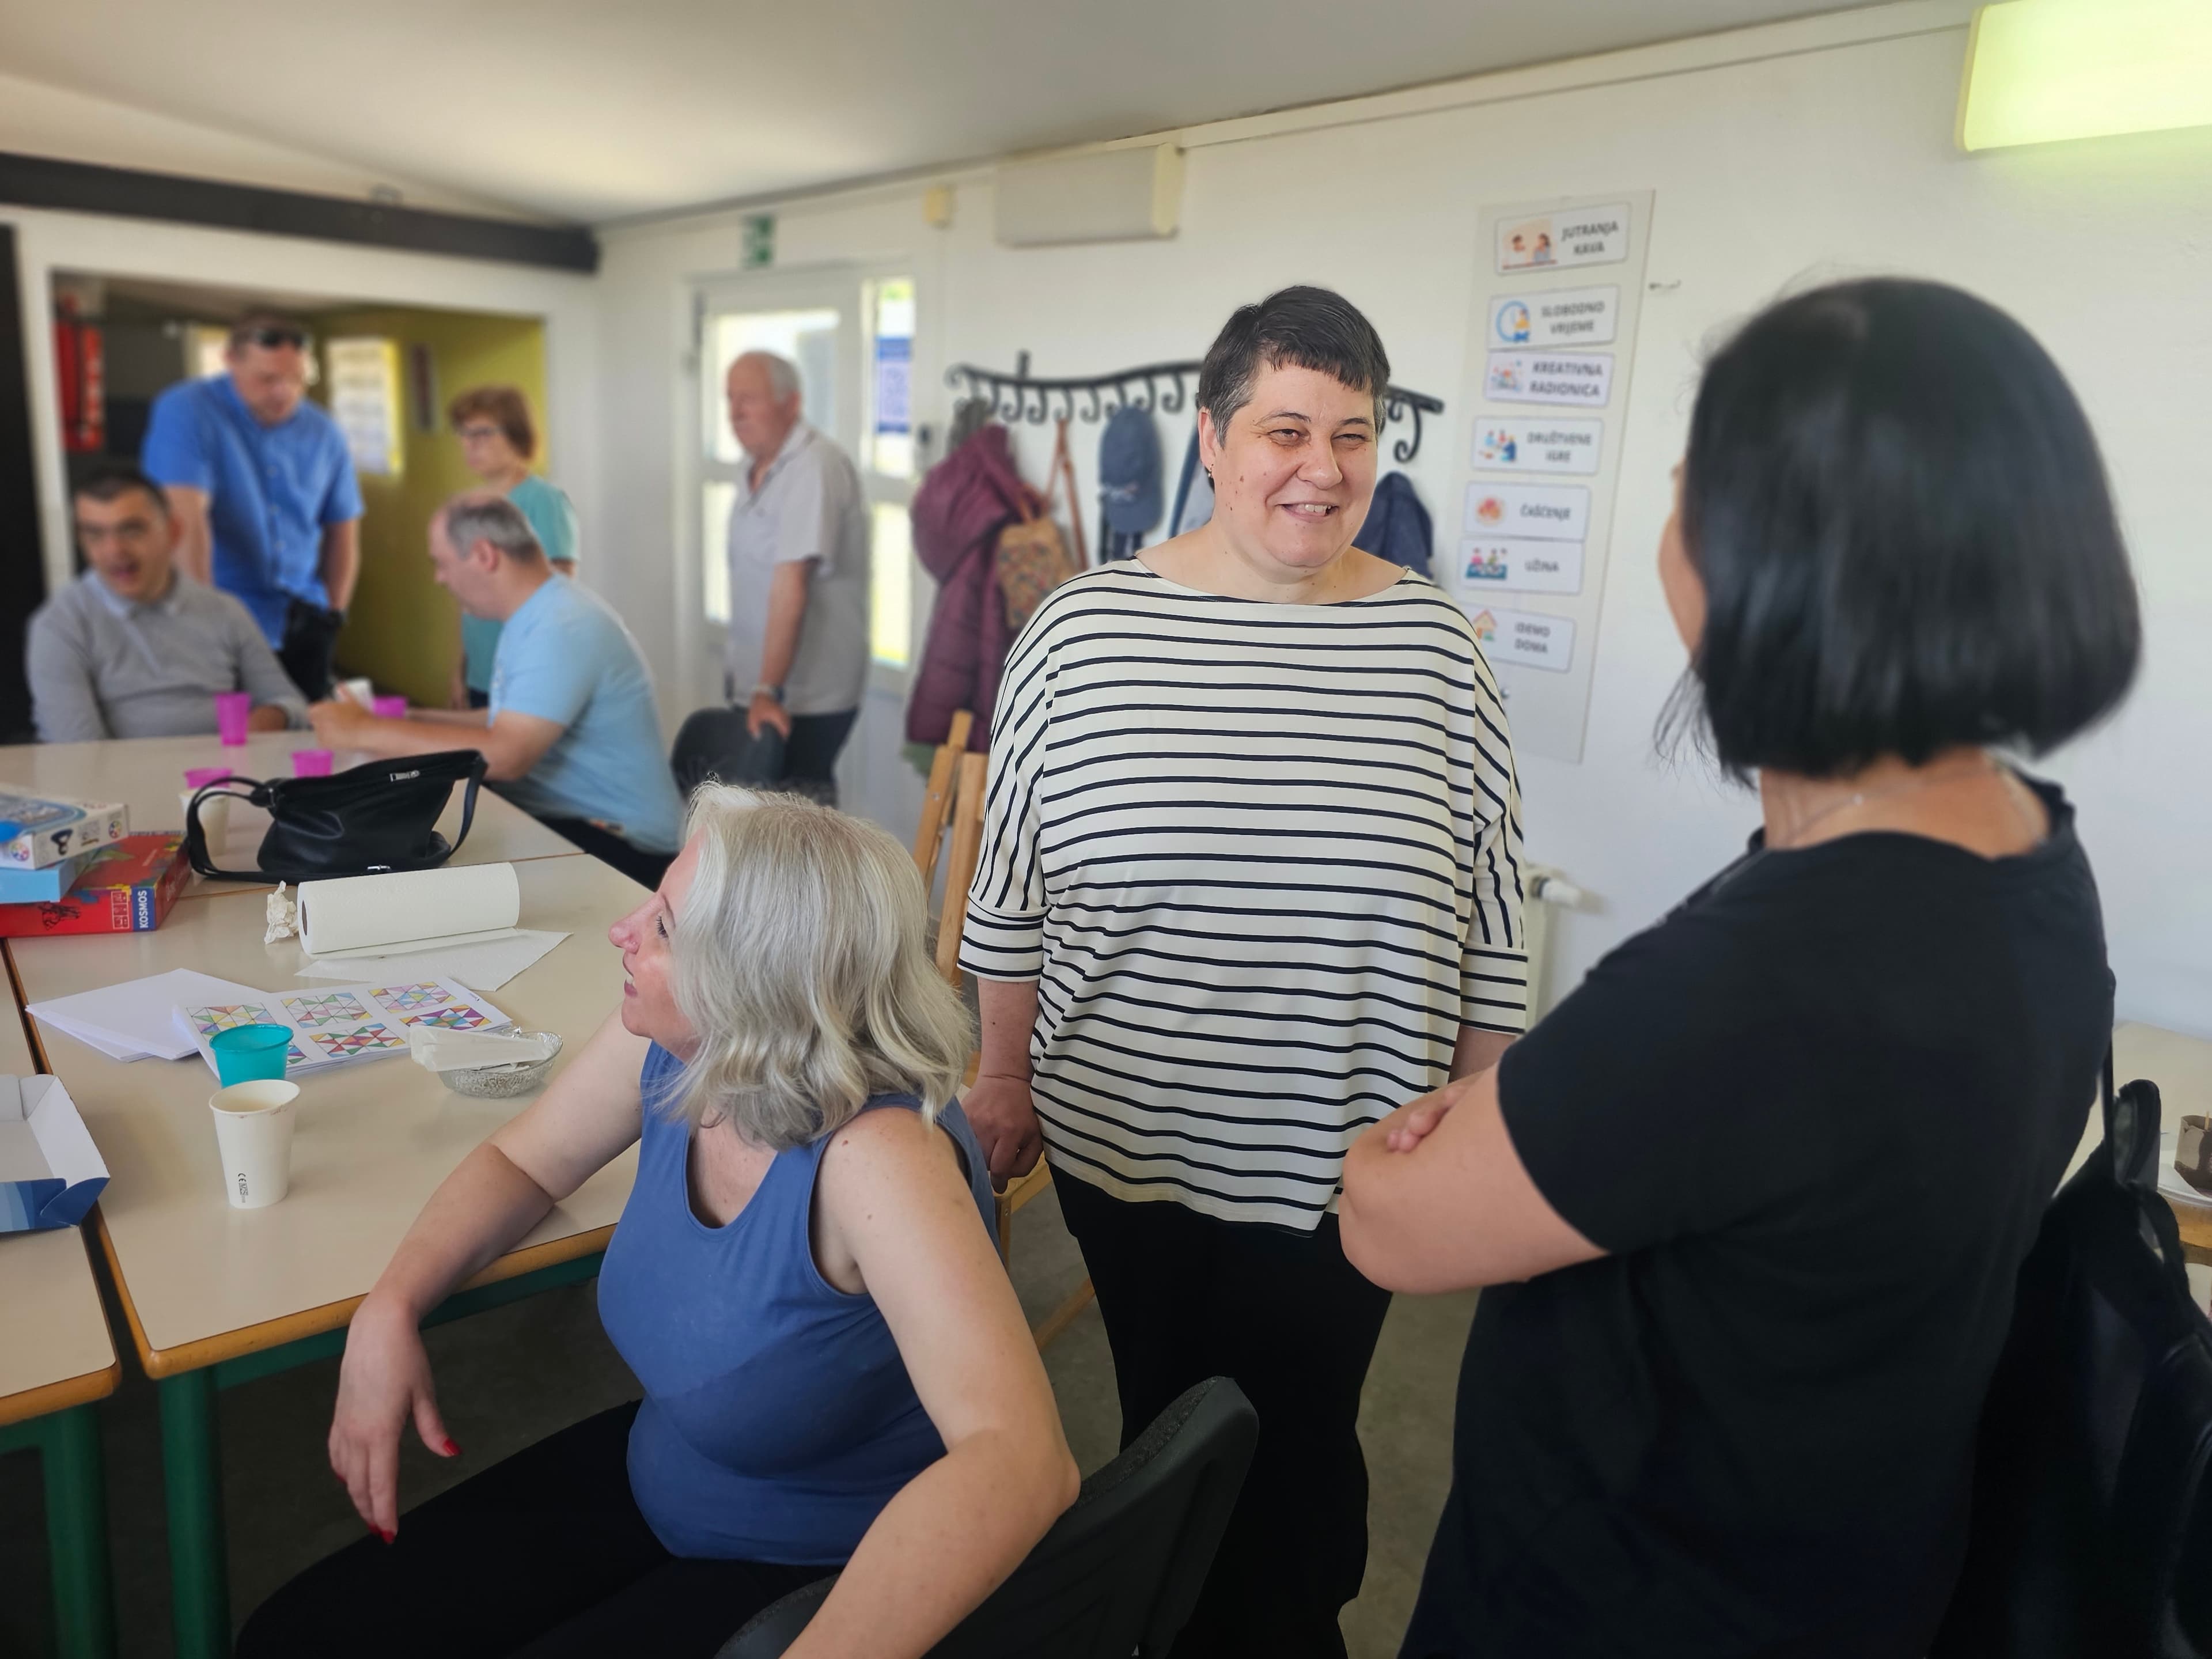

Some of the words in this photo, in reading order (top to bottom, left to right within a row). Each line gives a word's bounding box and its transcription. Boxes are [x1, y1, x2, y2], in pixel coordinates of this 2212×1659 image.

[1541, 302, 1604, 317] SLOBODNO
[1533, 361, 1603, 376] KREATIVNA
[1530, 381, 1600, 396] RADIONICA
[1515, 622, 1551, 638] IDEMO
[1514, 639, 1548, 653] DOMA
[138, 889, 148, 929] KOSMOS
